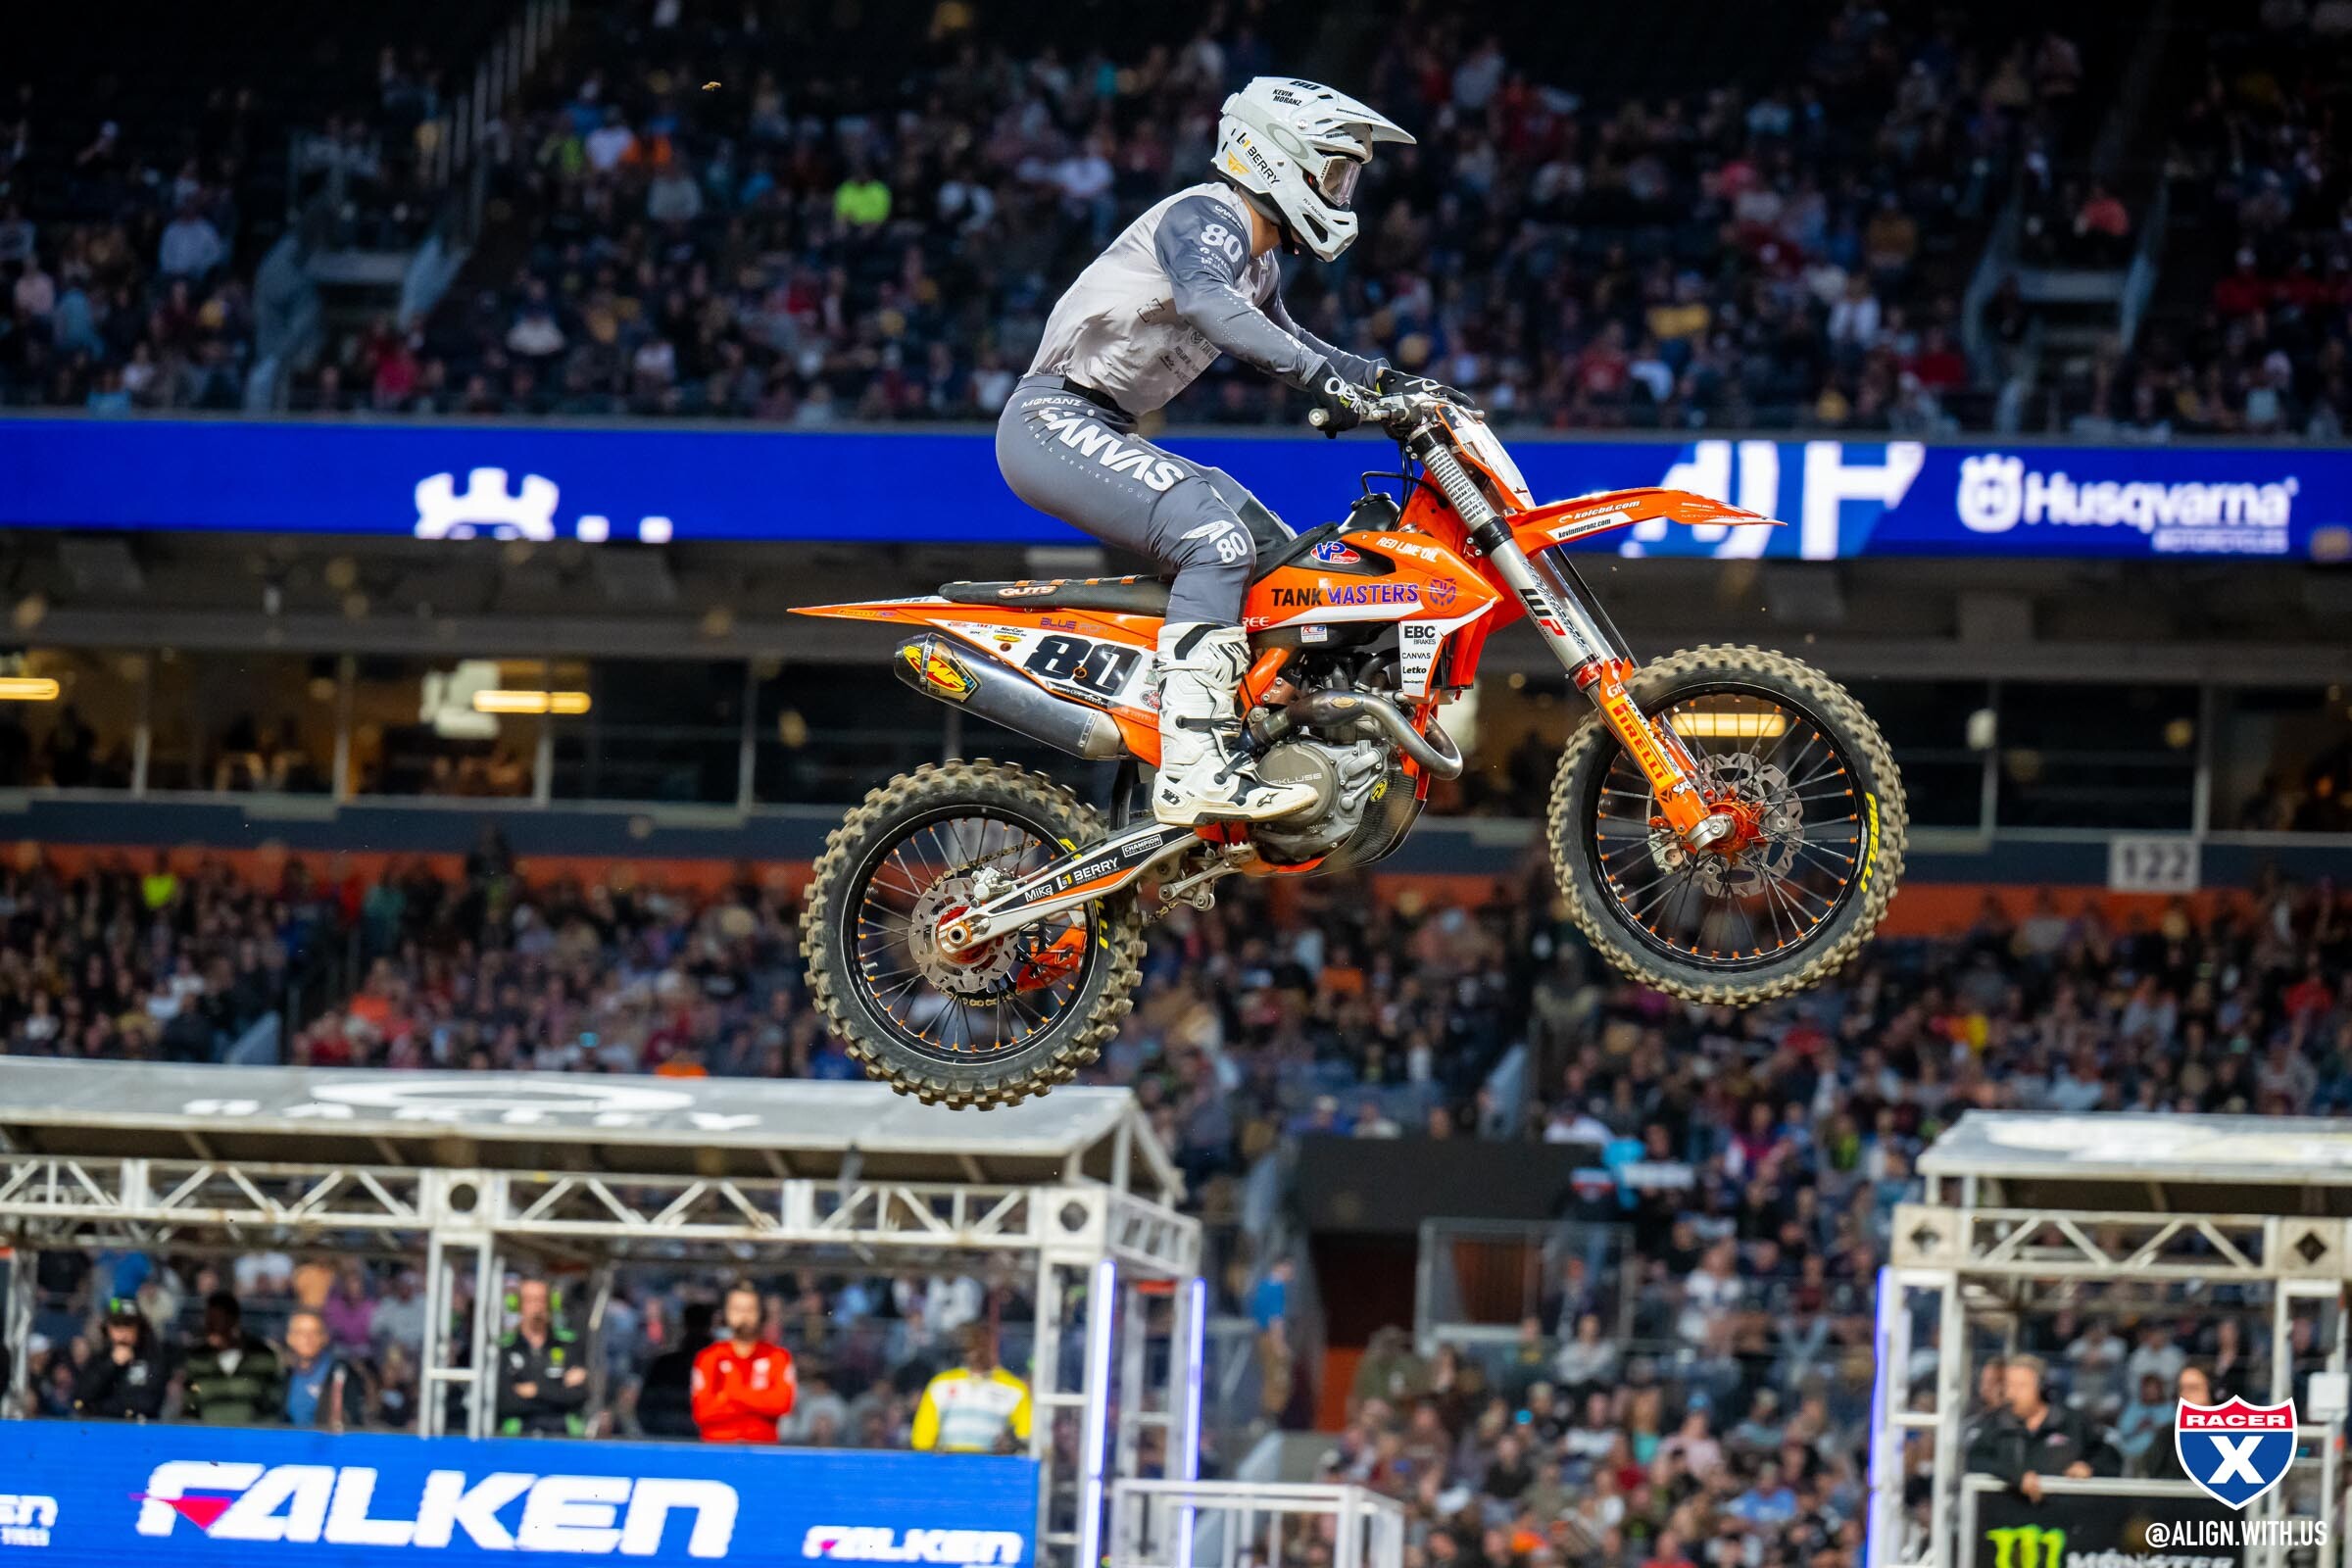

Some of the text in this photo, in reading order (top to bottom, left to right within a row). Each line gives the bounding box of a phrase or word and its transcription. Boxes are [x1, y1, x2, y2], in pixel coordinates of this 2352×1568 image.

[1272, 95, 1302, 106] MORANZ
[1247, 146, 1281, 184] BERRY
[1200, 223, 1244, 263] 80
[1020, 397, 1083, 409] MORANZ
[2024, 471, 2291, 534] Husqvarna
[1558, 518, 1611, 539] kevinmoranz.com
[1216, 531, 1249, 564] 80
[1316, 541, 1347, 563] VP
[1376, 536, 1440, 564] RED LINE OIL
[998, 586, 1057, 598] GUTS
[1271, 583, 1420, 607] TANK MASTERS
[1040, 617, 1077, 629] BLUE
[1404, 625, 1436, 639] EBC
[1022, 634, 1143, 697] 80
[1402, 665, 1427, 674] Letko
[1612, 702, 1664, 780] PIRELLI
[1269, 772, 1323, 785] EKLUSE
[1124, 836, 1160, 853] CHAMPION
[1859, 791, 1880, 894] PIRELLI
[1073, 857, 1118, 881] BERRY
[1024, 884, 1054, 903] Mika
[135, 1459, 739, 1558] FALKEN
[802, 1525, 1024, 1564] FALKEN
